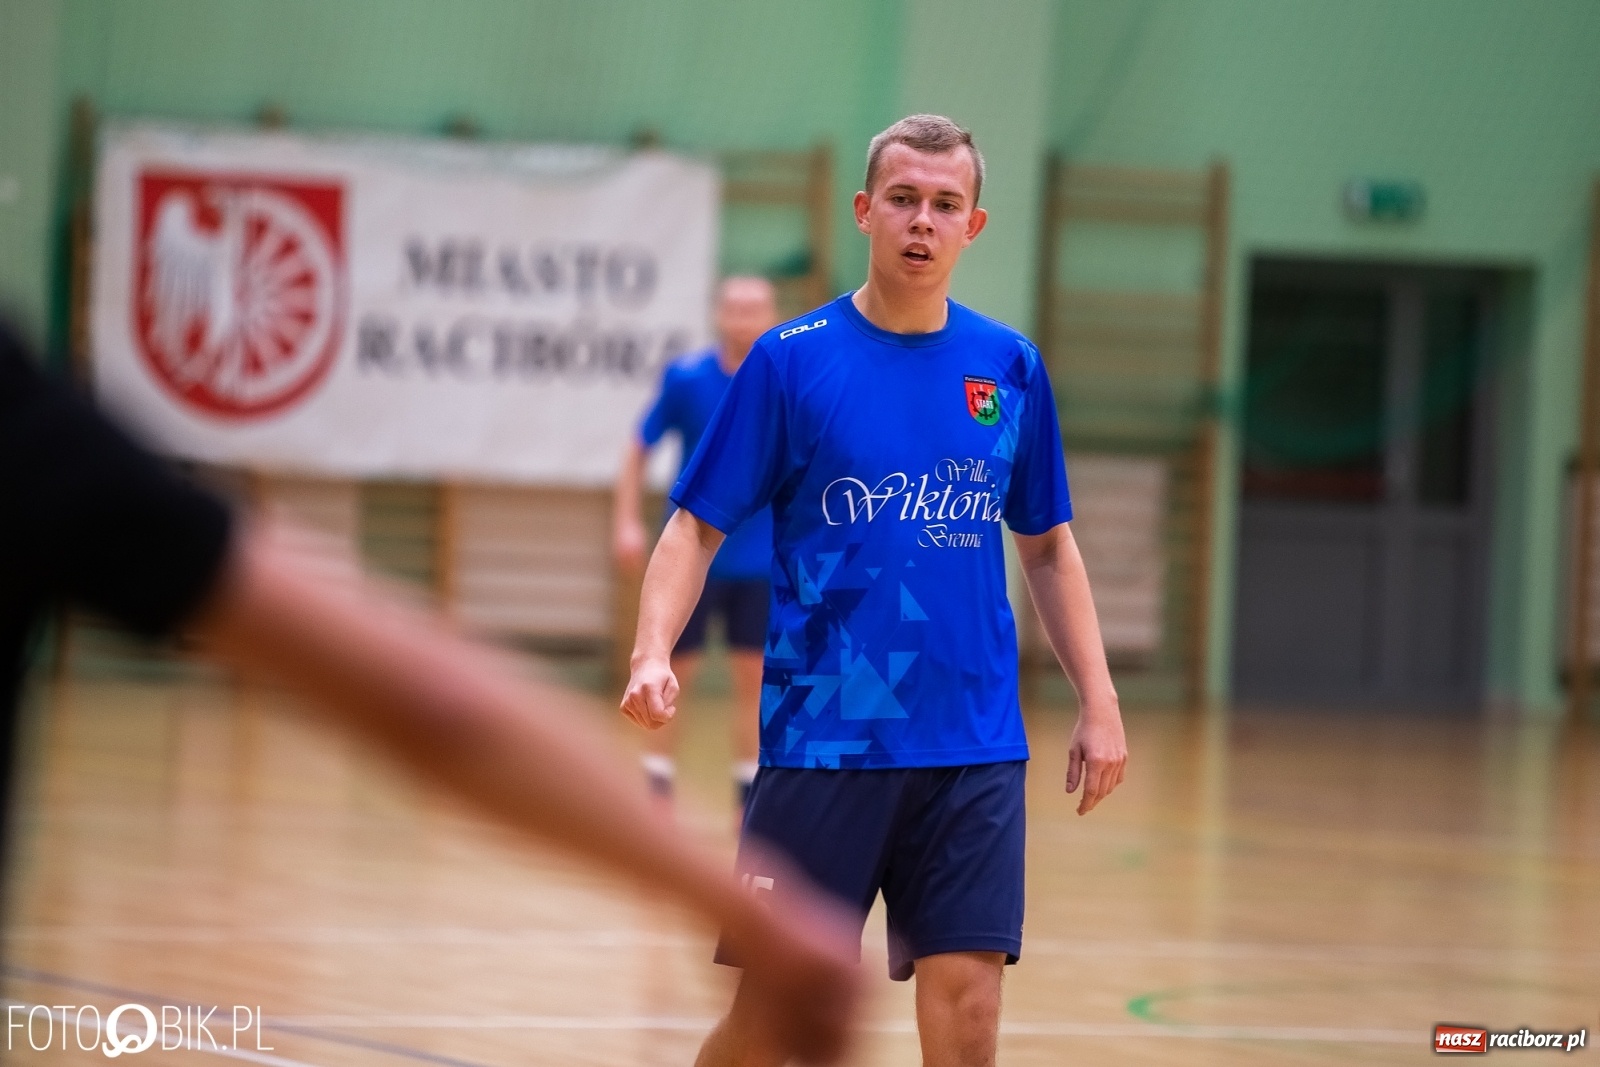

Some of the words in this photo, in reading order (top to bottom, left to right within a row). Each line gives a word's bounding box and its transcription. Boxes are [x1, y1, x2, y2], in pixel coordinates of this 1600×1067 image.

[402, 237, 657, 310] MIASTO
[780, 319, 827, 340] COLO
[822, 472, 1001, 526] Wiktoria
